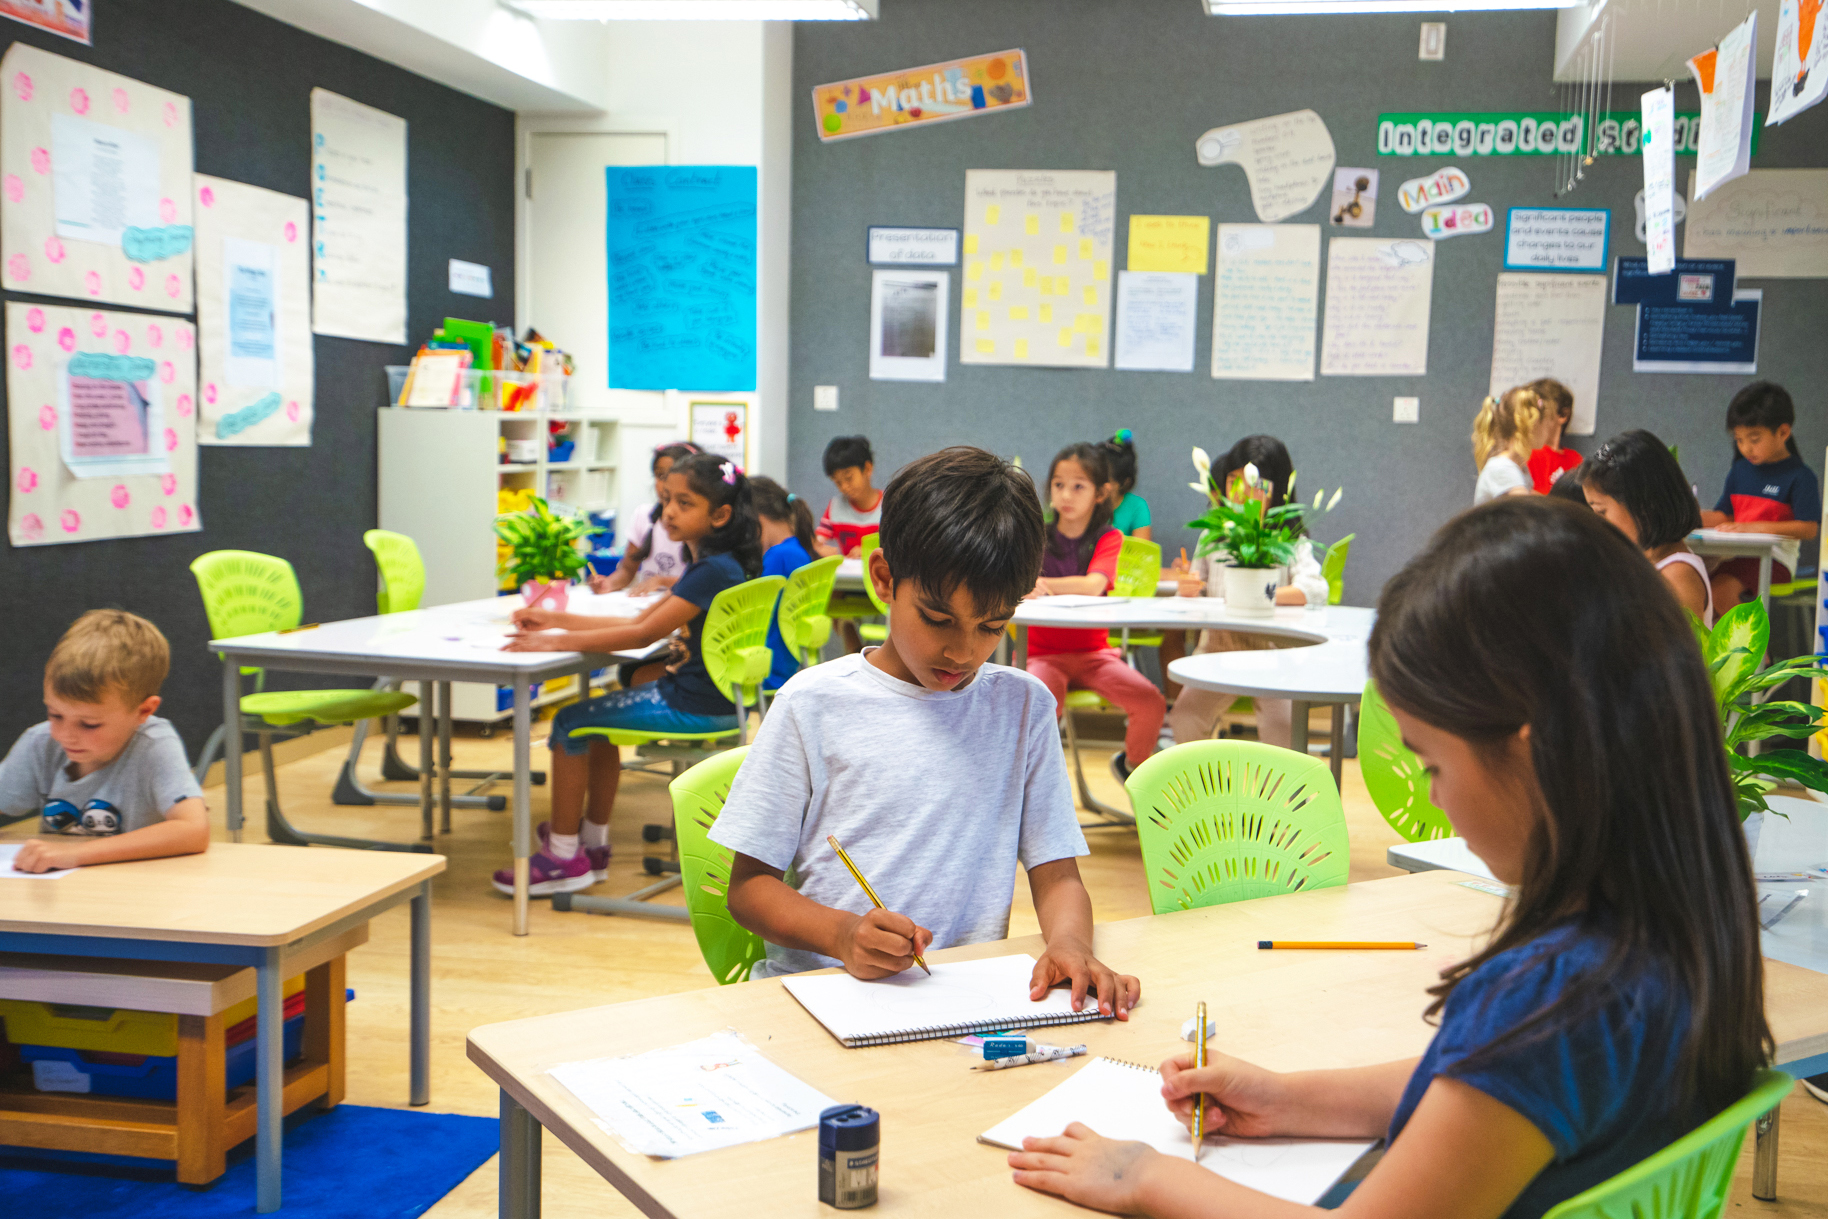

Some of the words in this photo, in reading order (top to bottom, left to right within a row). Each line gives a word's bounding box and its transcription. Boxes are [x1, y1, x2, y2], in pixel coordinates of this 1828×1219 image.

[870, 73, 972, 115] Maths
[1383, 123, 1577, 148] Integrated
[1403, 173, 1466, 209] Main
[1424, 208, 1489, 234] Idea
[1513, 211, 1564, 222] Significant
[1568, 212, 1604, 224] people
[871, 230, 954, 243] Presentation
[1511, 226, 1532, 235] and
[1534, 226, 1569, 235] events
[1571, 227, 1603, 236] cause
[1516, 239, 1562, 250] changes
[1563, 240, 1575, 249] to
[1577, 241, 1595, 249] our
[889, 248, 904, 260] of
[904, 248, 936, 260] data
[1530, 254, 1555, 264] daily
[1557, 254, 1580, 263] lives
